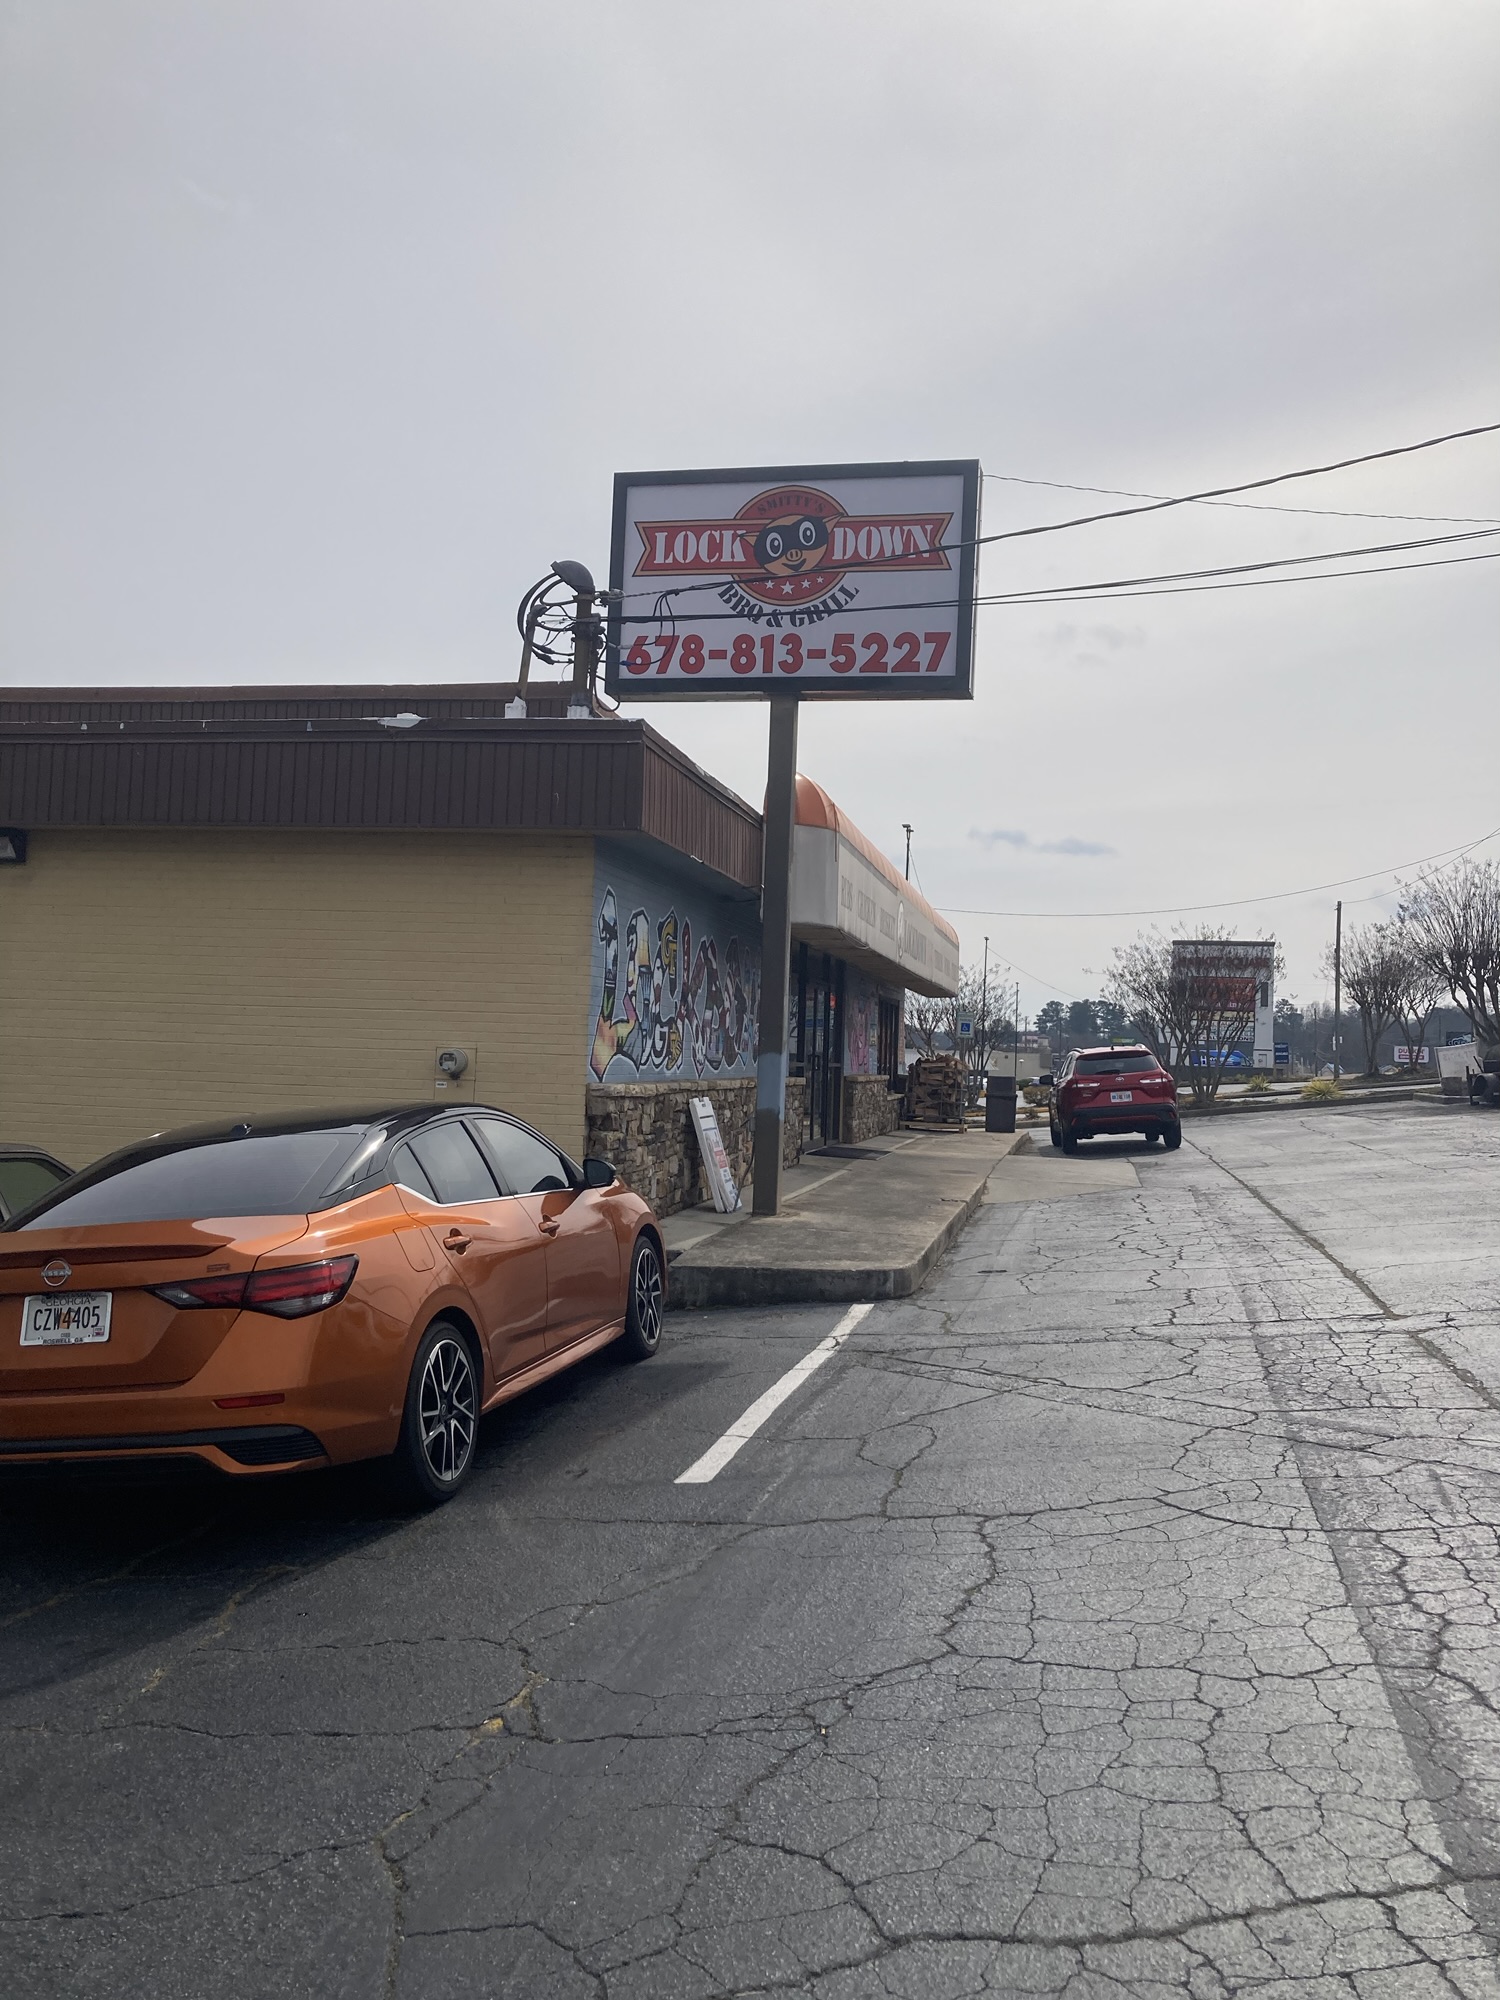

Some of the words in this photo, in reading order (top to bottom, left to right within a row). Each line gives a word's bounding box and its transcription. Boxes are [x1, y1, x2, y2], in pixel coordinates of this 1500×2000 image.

[757, 494, 826, 516] SMITTY'S
[653, 530, 747, 564] LOCK
[832, 524, 934, 560] DOWN
[717, 584, 765, 624] BBQ
[766, 608, 784, 628] &
[789, 584, 860, 628] GRILL
[626, 631, 951, 675] 678-813-5227
[41, 1269, 71, 1277] NISSAN
[33, 1305, 100, 1332] CZW4405
